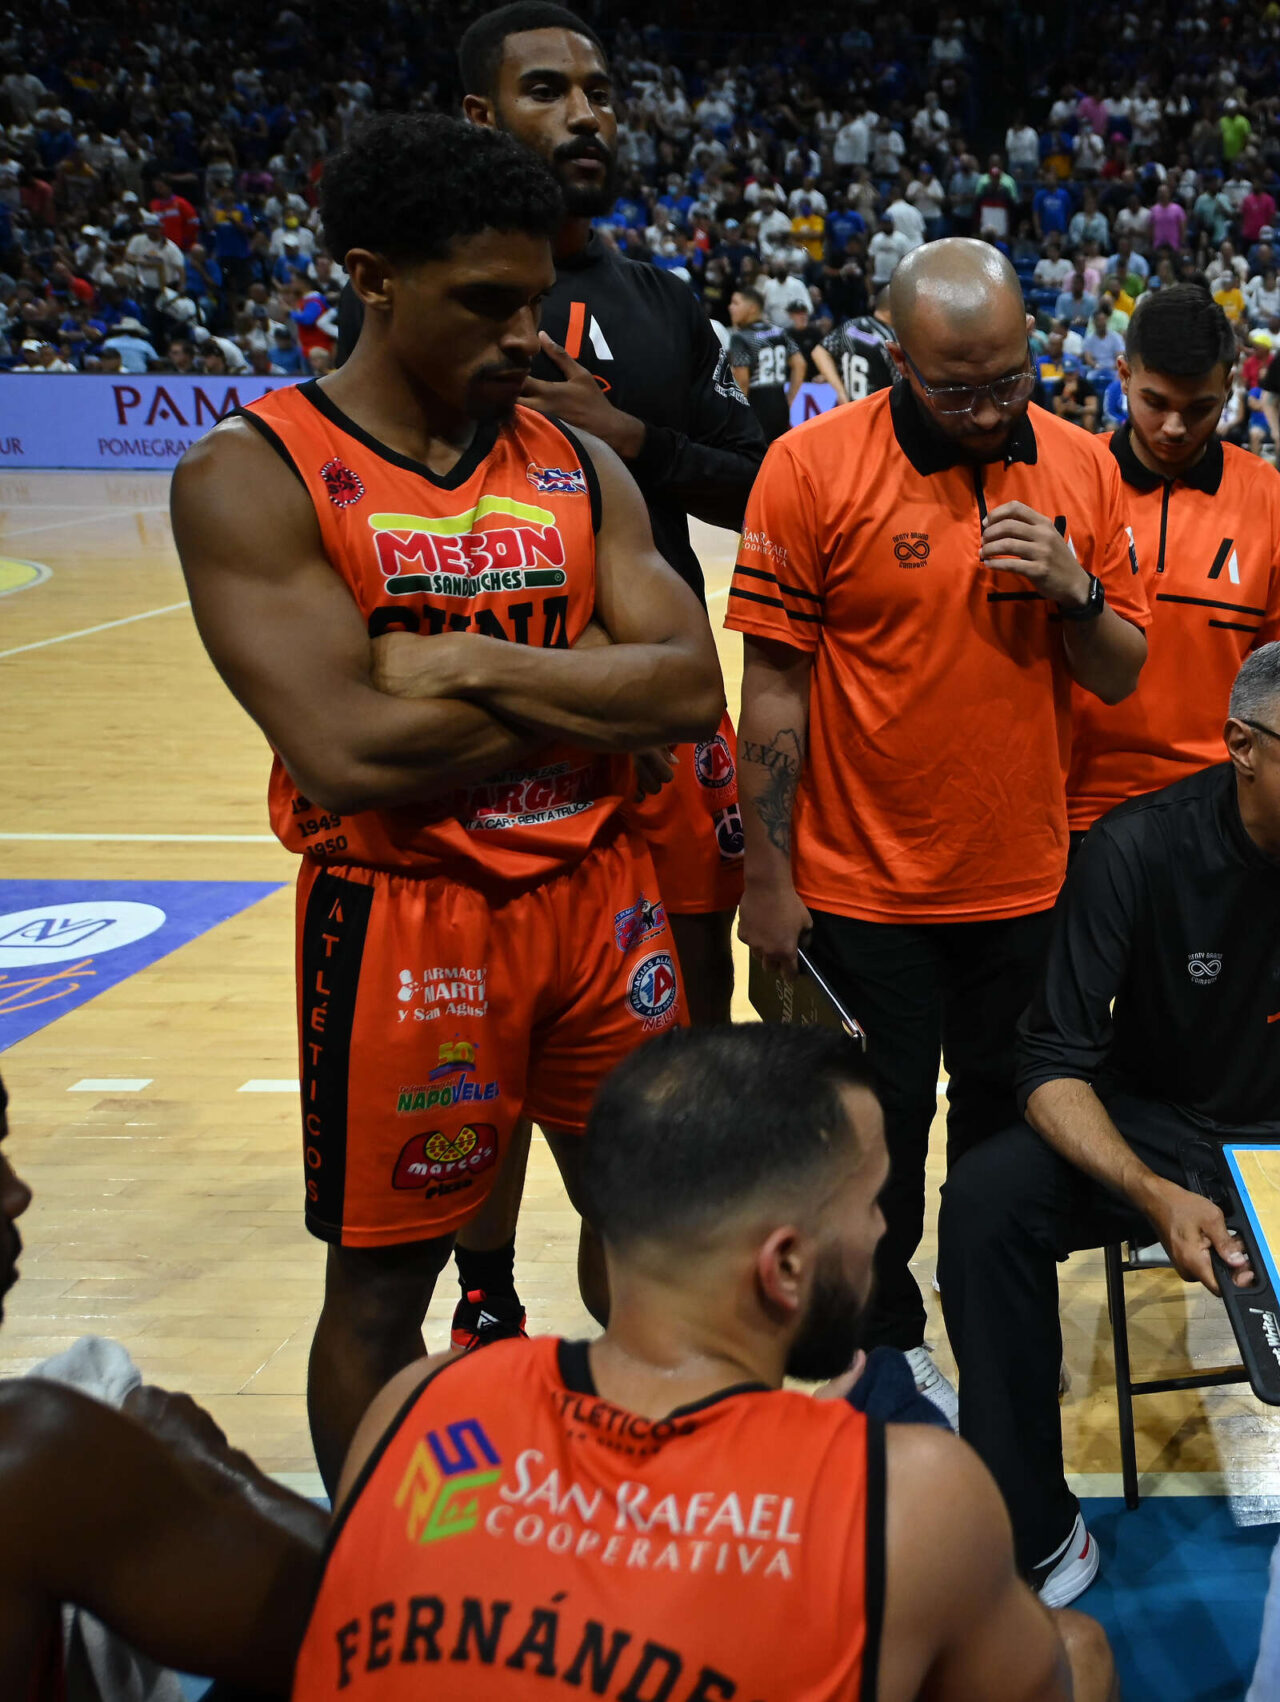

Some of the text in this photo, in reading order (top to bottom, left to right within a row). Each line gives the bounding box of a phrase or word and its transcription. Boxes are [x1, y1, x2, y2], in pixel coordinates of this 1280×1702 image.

[98, 437, 197, 457] POMEGRA
[373, 525, 566, 577] MESON
[432, 570, 524, 598] SANDWICHES
[398, 1002, 489, 1023] y San Agus
[397, 1072, 500, 1112] NAPOVELE
[408, 1147, 493, 1176] marco's
[500, 1448, 801, 1545] SAN RAFAEL
[485, 1504, 793, 1582] COOPERATIVA
[335, 1591, 745, 1702] FERNÁNDE
